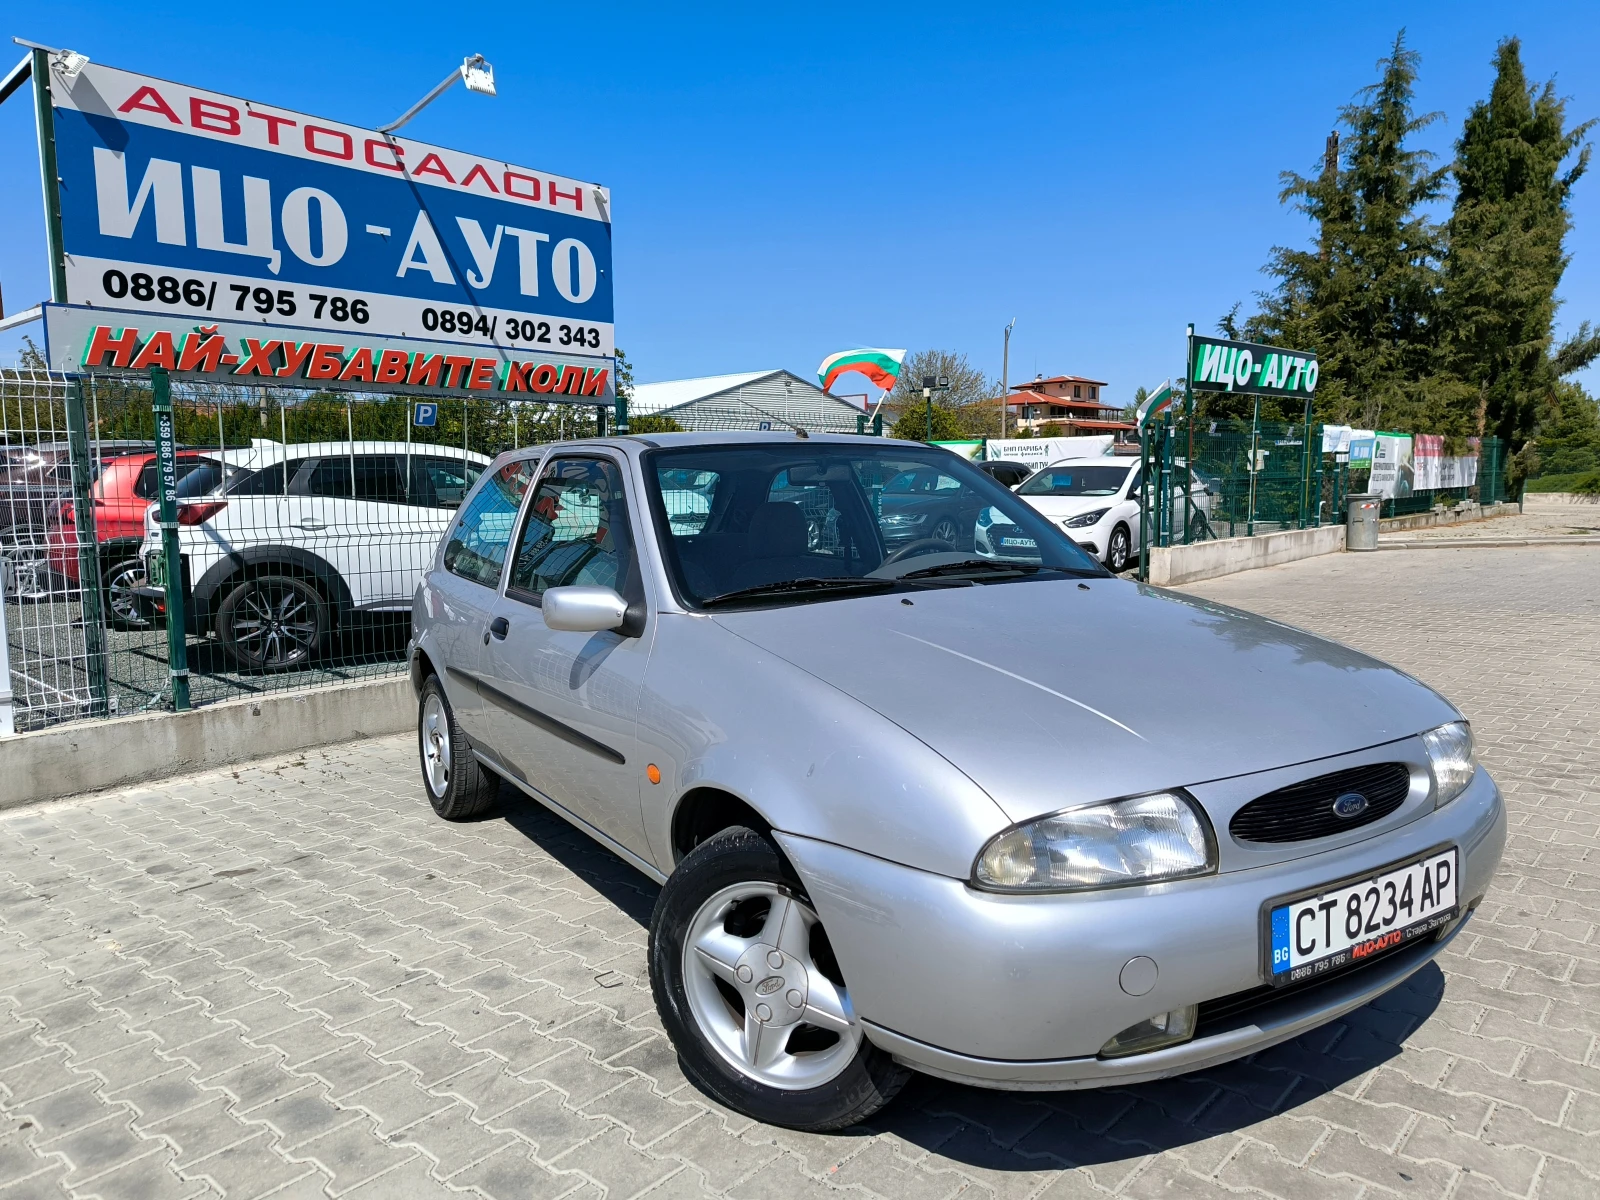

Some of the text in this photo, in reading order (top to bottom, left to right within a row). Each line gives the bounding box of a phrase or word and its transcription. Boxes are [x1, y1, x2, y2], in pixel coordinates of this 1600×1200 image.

[117, 85, 583, 212] АВТОСАЛОН
[102, 269, 370, 325] 0886/ 795 786
[421, 308, 601, 349] 0894/ 302 343
[83, 323, 609, 397] НАЙ-ХУБАВИТЕ КОЛИ
[1197, 343, 1319, 393] ИЦО-АУТО
[418, 405, 433, 423] P
[160, 414, 176, 502] +359 886 79 57 86
[1343, 798, 1361, 813] Ford
[1295, 859, 1451, 957] CT 8234 AP
[1273, 946, 1289, 964] BG
[1290, 912, 1452, 981] 0886 795 786 ИЦО-АУТО Стара Загора
